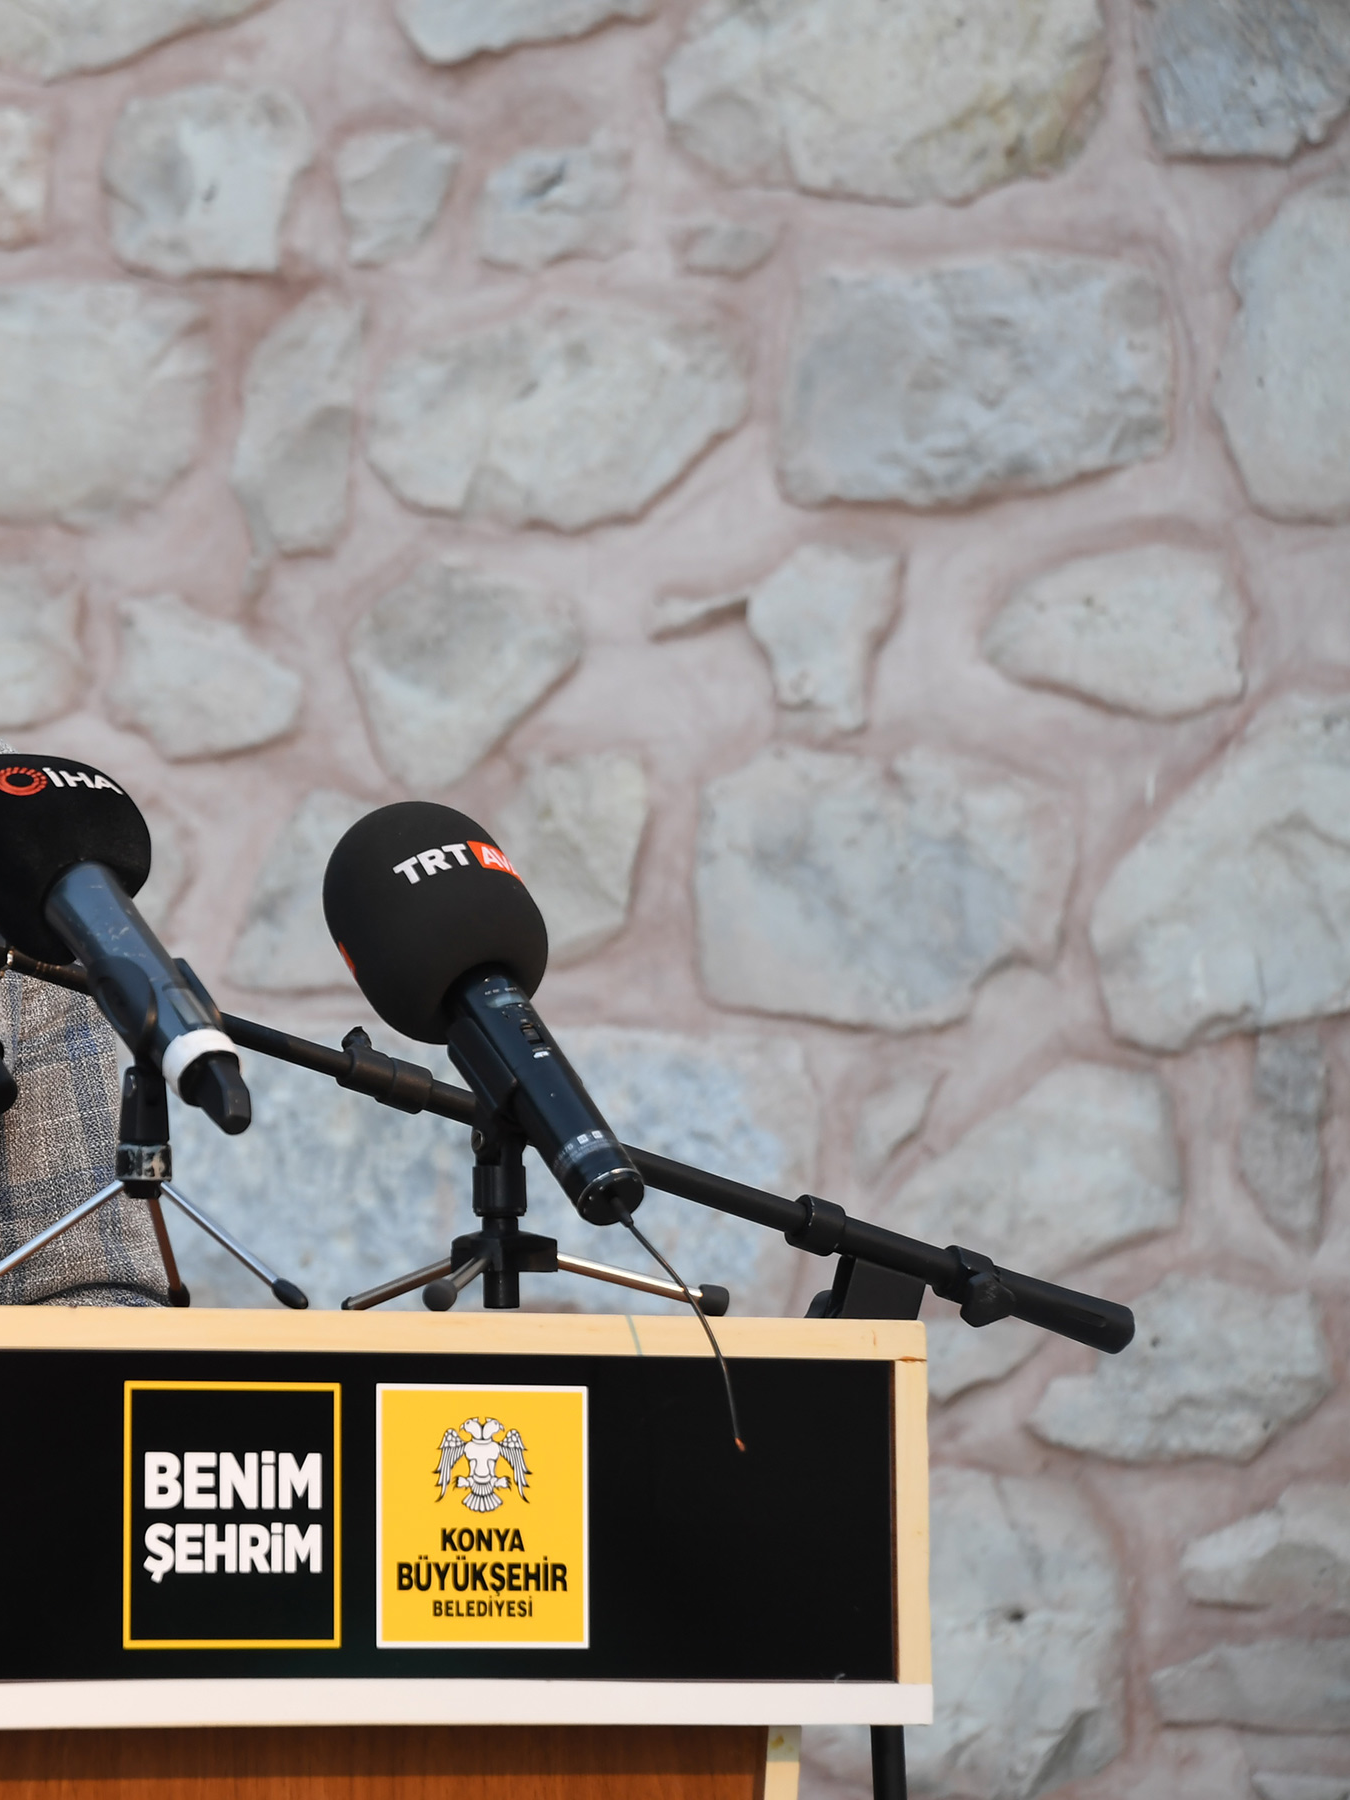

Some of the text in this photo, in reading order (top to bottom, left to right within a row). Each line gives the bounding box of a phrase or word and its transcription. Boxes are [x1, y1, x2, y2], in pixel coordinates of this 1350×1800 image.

[392, 843, 470, 885] TRT
[441, 1528, 525, 1552] KONYA
[396, 1555, 568, 1597] BÜYÜKŞEHİR
[432, 1596, 533, 1618] BELEDİYESİ
